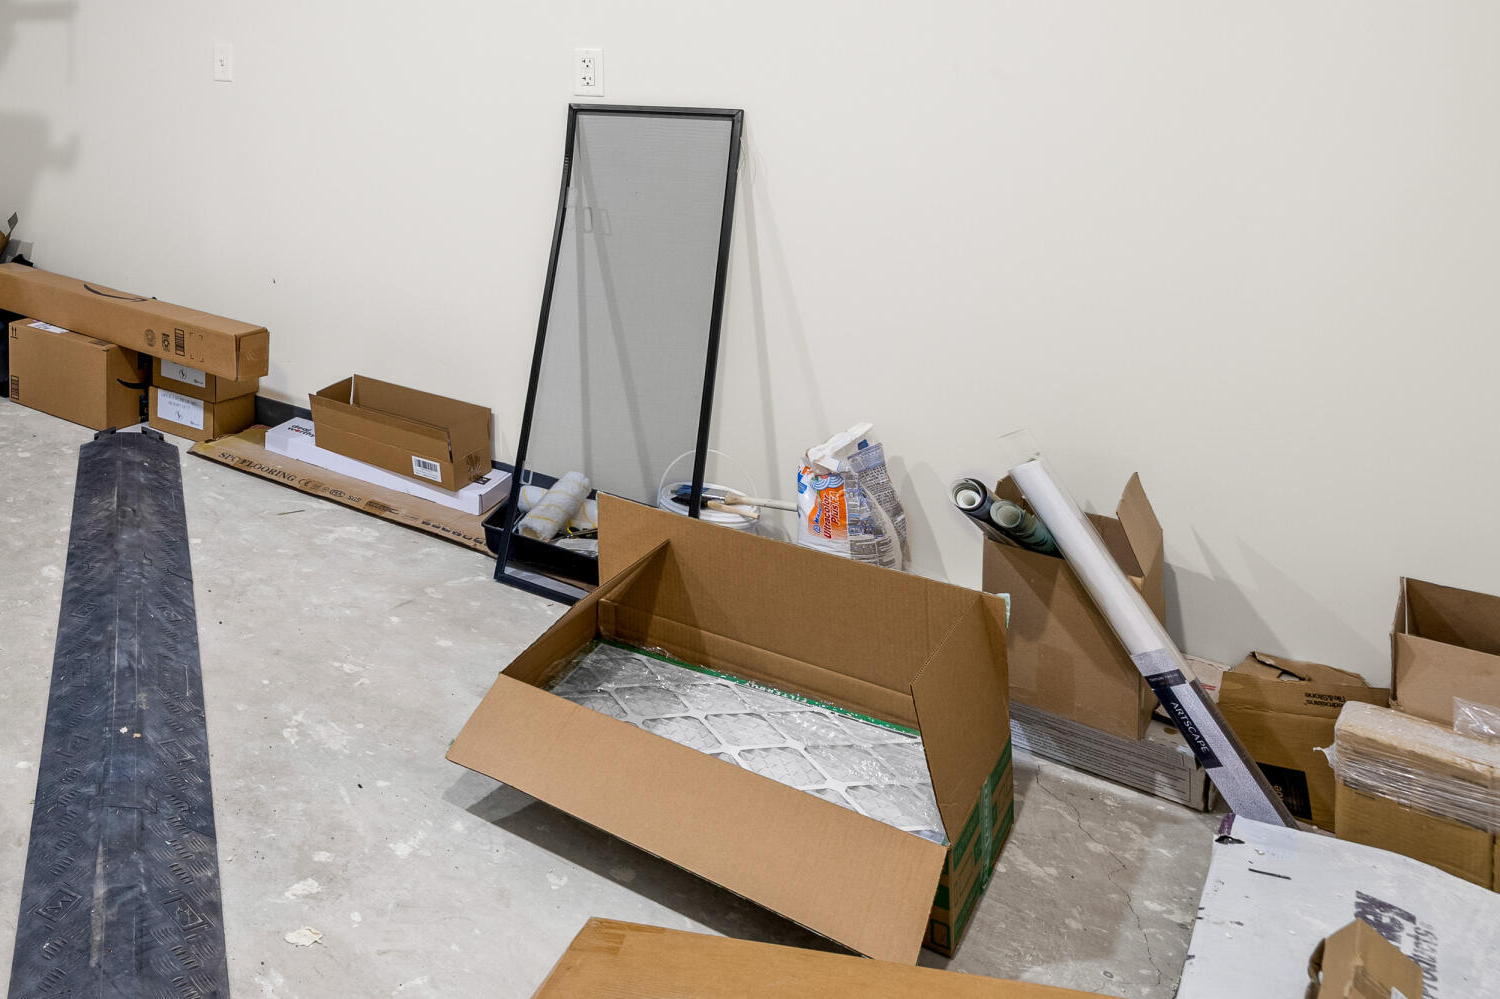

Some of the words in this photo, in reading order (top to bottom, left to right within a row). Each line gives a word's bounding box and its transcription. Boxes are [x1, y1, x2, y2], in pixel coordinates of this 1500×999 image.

[218, 451, 240, 463] SPC
[239, 458, 297, 482] FLOORING
[822, 494, 832, 539] Ultracolor
[831, 505, 840, 525] Plus
[1170, 701, 1210, 754] ARTSCAPE
